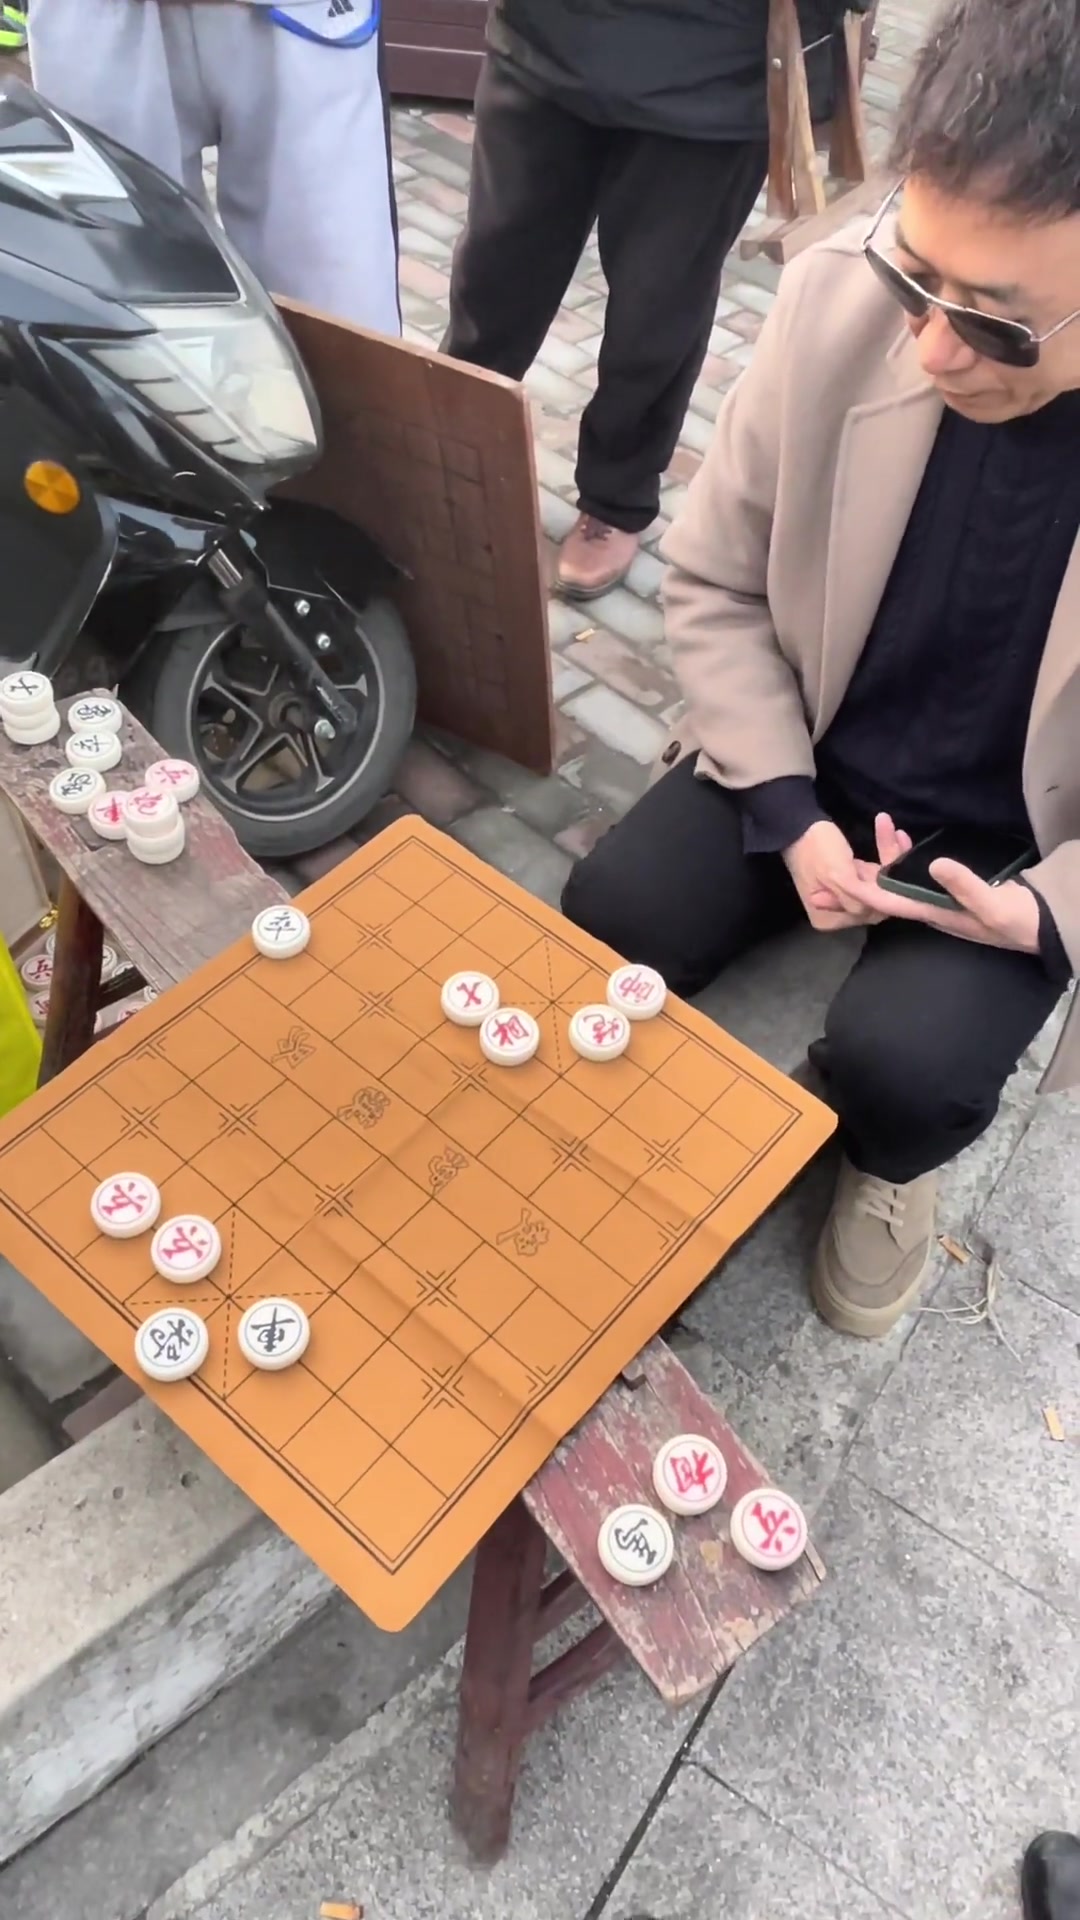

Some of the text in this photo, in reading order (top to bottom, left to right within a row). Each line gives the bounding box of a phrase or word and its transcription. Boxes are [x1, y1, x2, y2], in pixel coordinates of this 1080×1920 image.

[73, 735, 109, 752] 卒
[155, 766, 190, 785] 兵
[129, 791, 163, 815] 炮
[264, 912, 297, 941] 卒
[492, 1015, 530, 1047] 相
[582, 1013, 621, 1045] 炮
[102, 1182, 147, 1216] 兵
[162, 1225, 208, 1260] 兵
[250, 1307, 296, 1353] 車
[670, 1449, 715, 1494] 相
[750, 1502, 797, 1552] 兵
